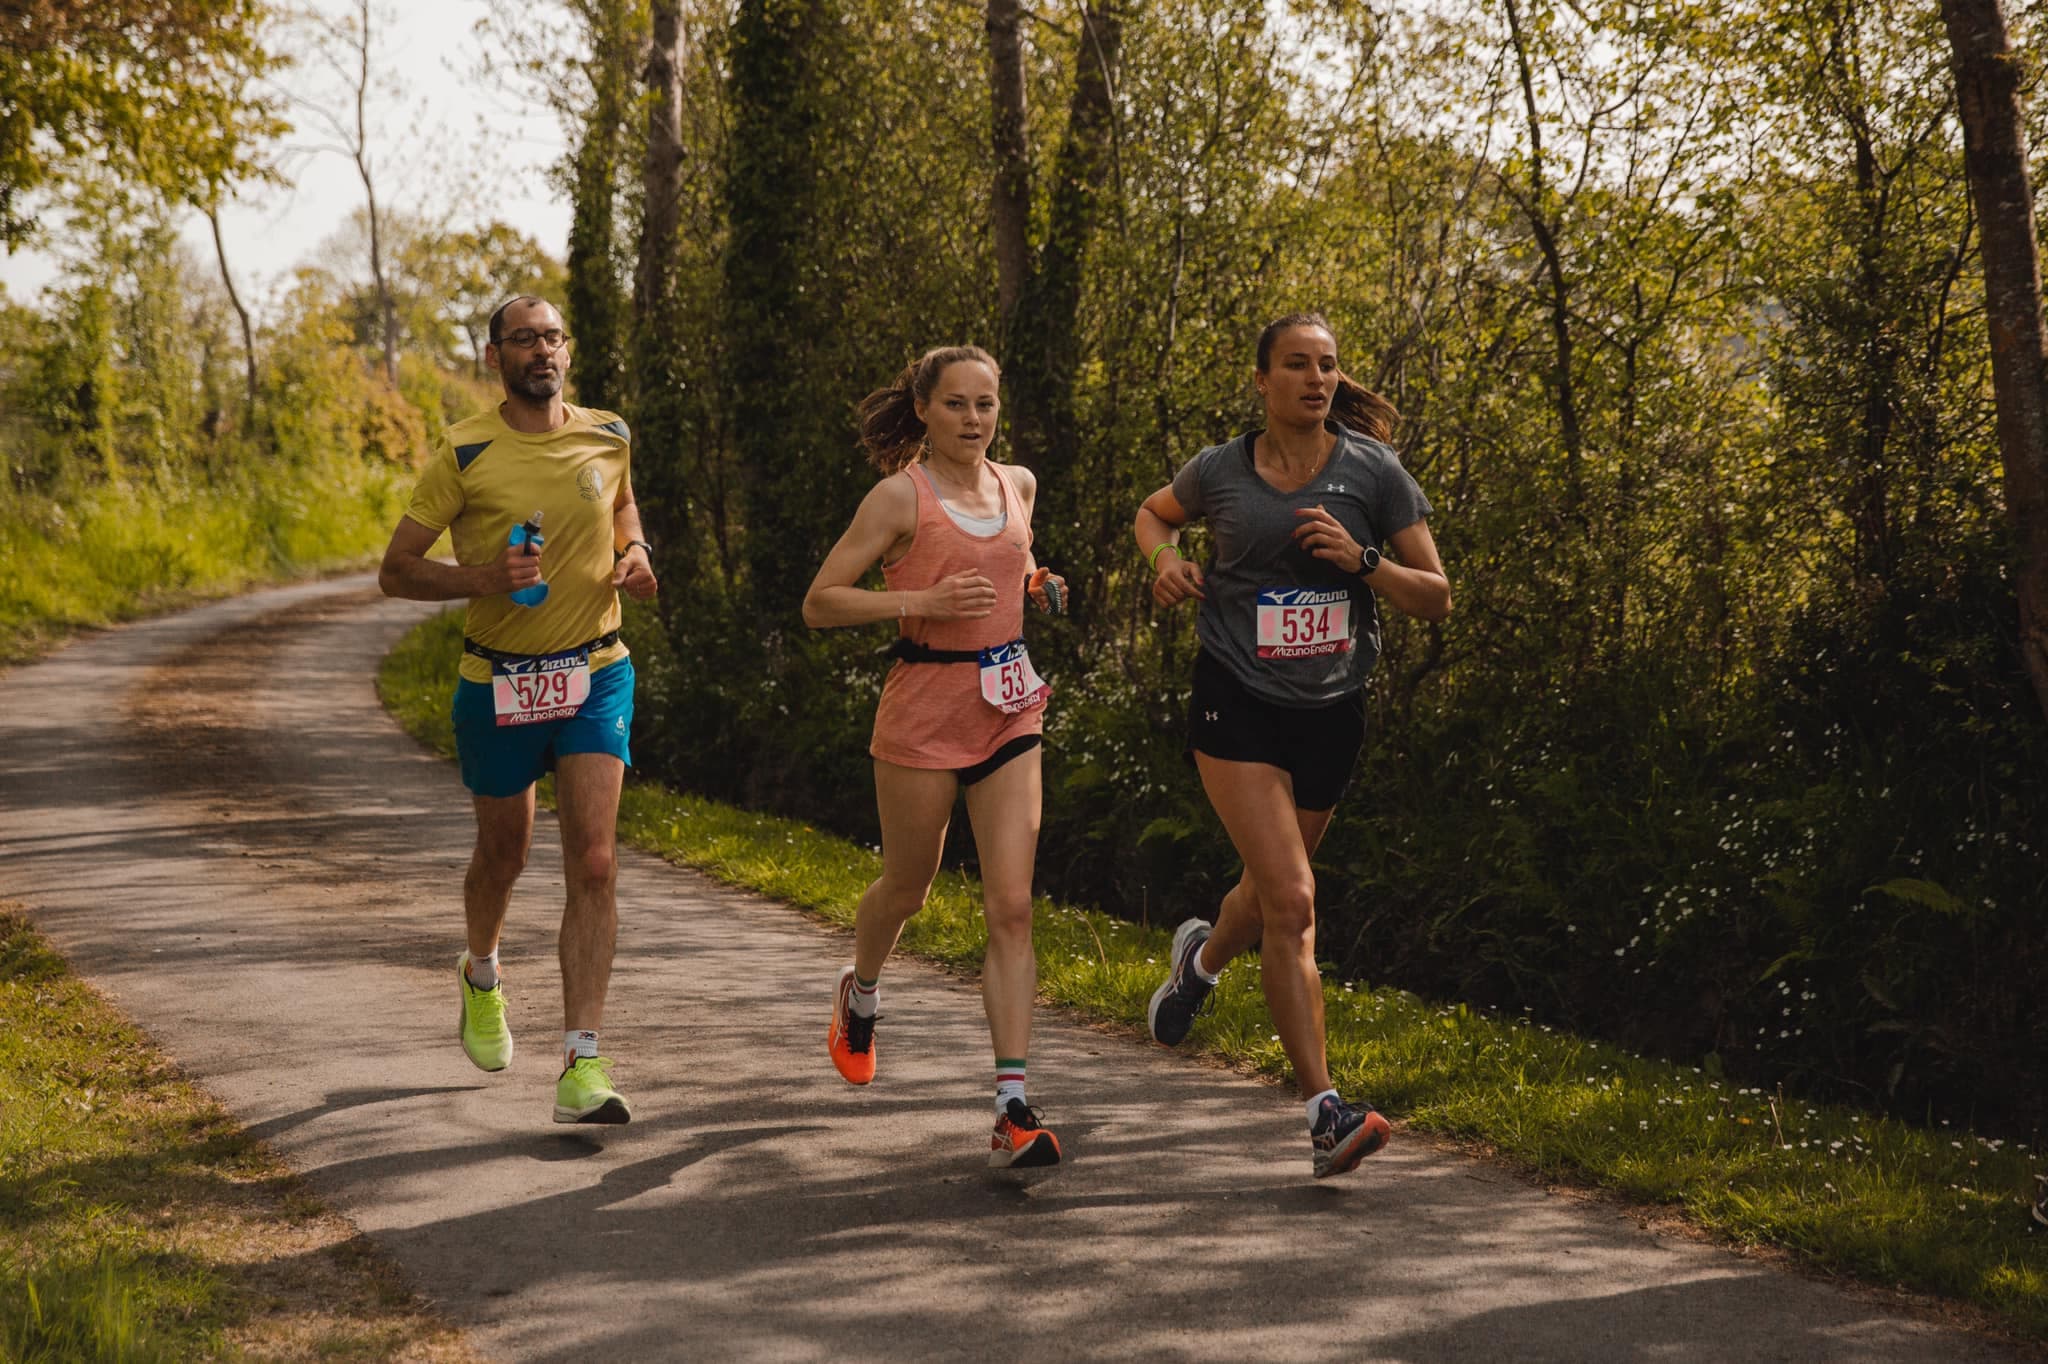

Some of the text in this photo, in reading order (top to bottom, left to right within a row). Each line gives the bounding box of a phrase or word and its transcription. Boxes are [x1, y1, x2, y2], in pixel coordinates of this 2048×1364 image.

[1282, 606, 1330, 644] 534
[517, 671, 568, 710] 529
[1001, 661, 1026, 701] 53
